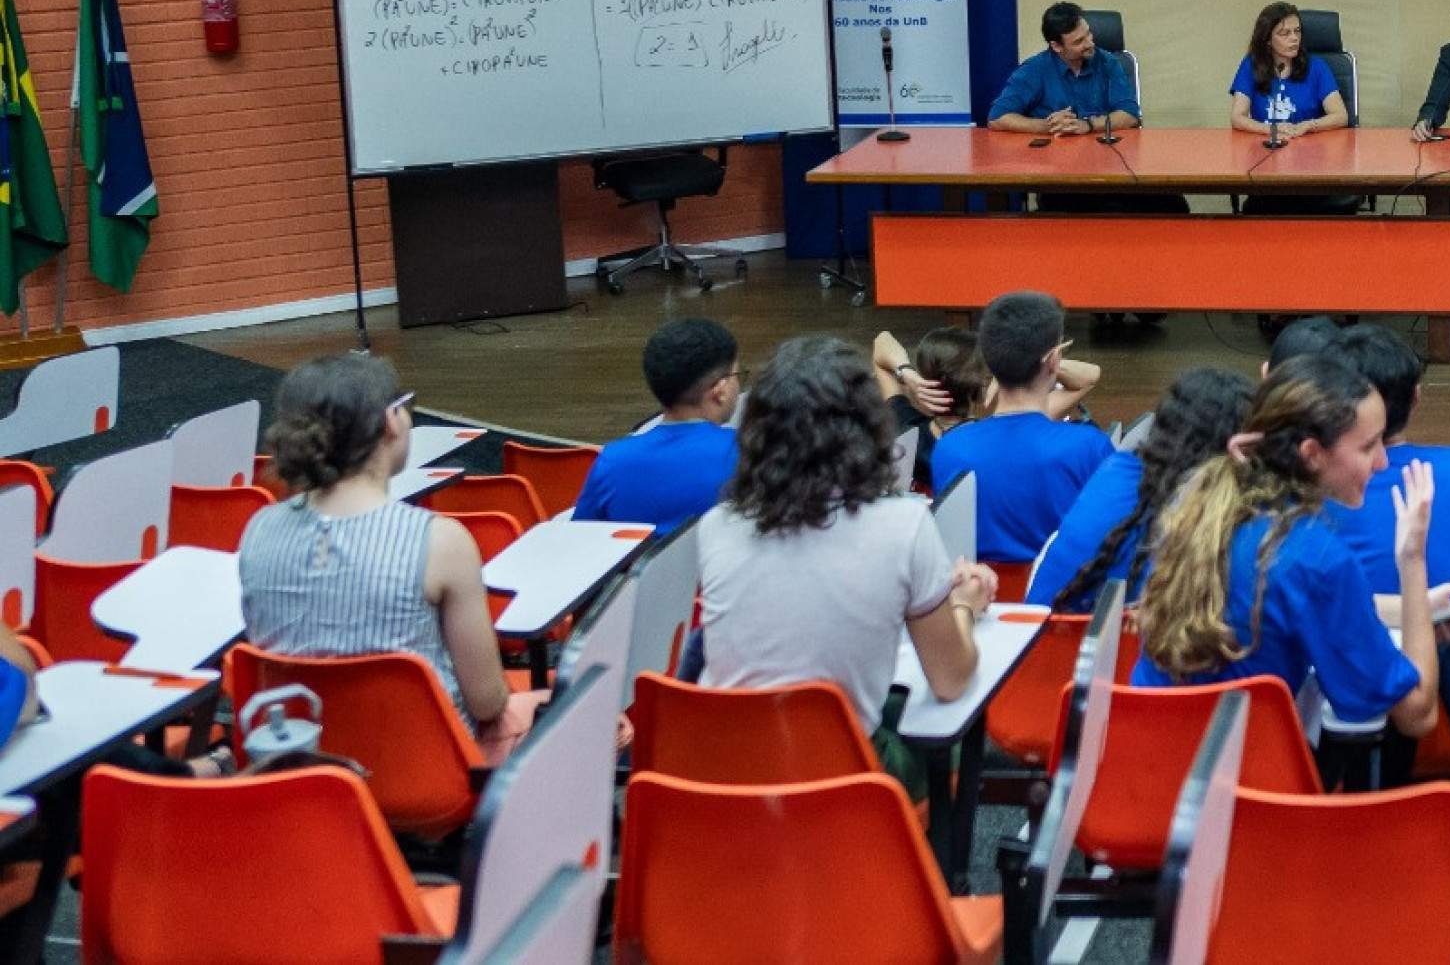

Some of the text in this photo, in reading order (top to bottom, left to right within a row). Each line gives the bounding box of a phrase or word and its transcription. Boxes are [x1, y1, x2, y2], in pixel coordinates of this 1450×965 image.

[869, 4, 892, 14] Nos
[834, 16, 928, 27] 60 anos da UnB
